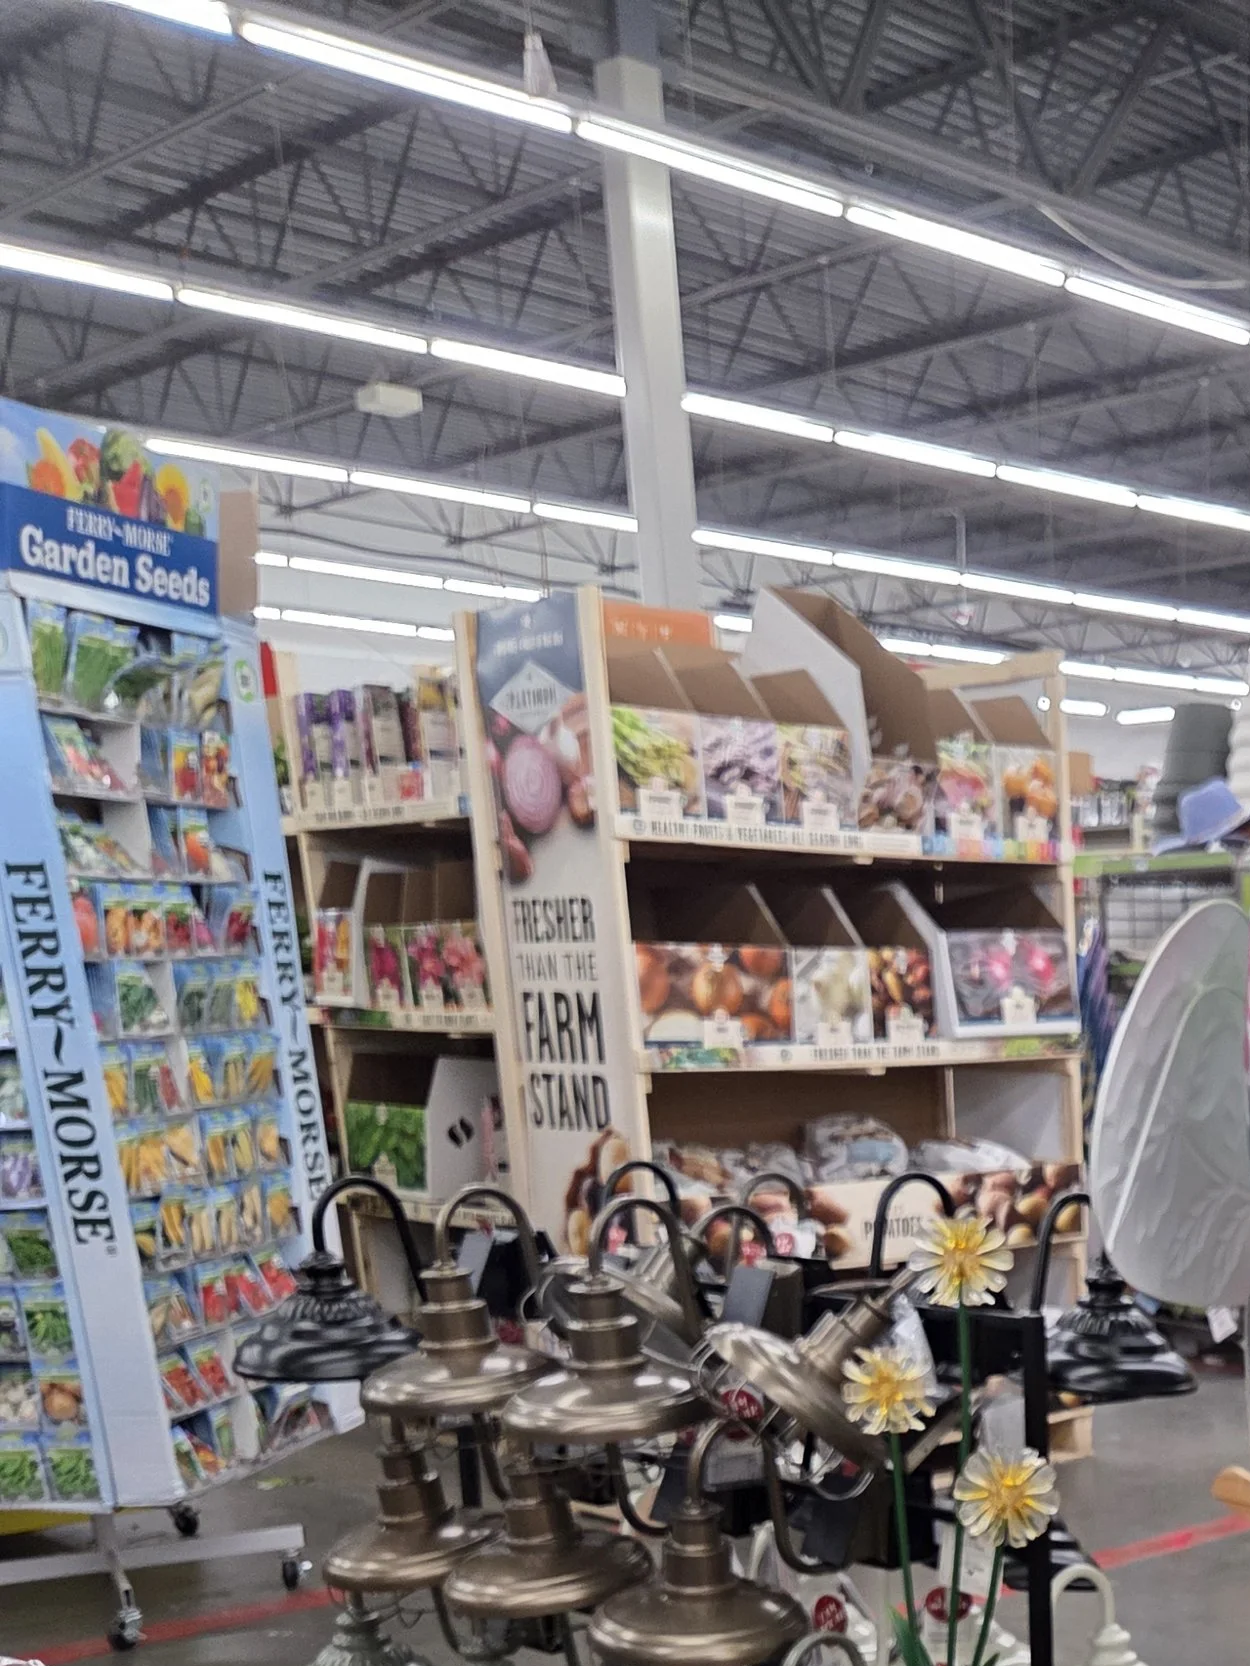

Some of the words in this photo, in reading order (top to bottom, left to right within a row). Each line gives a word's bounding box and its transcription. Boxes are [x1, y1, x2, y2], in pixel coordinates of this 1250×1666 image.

[20, 524, 130, 589] Garden
[134, 553, 211, 607] Seeds
[512, 896, 597, 944] FRESHER
[518, 952, 559, 981] THAN
[564, 952, 598, 982] THE
[522, 991, 606, 1065] FARM
[530, 1071, 612, 1133] STAND
